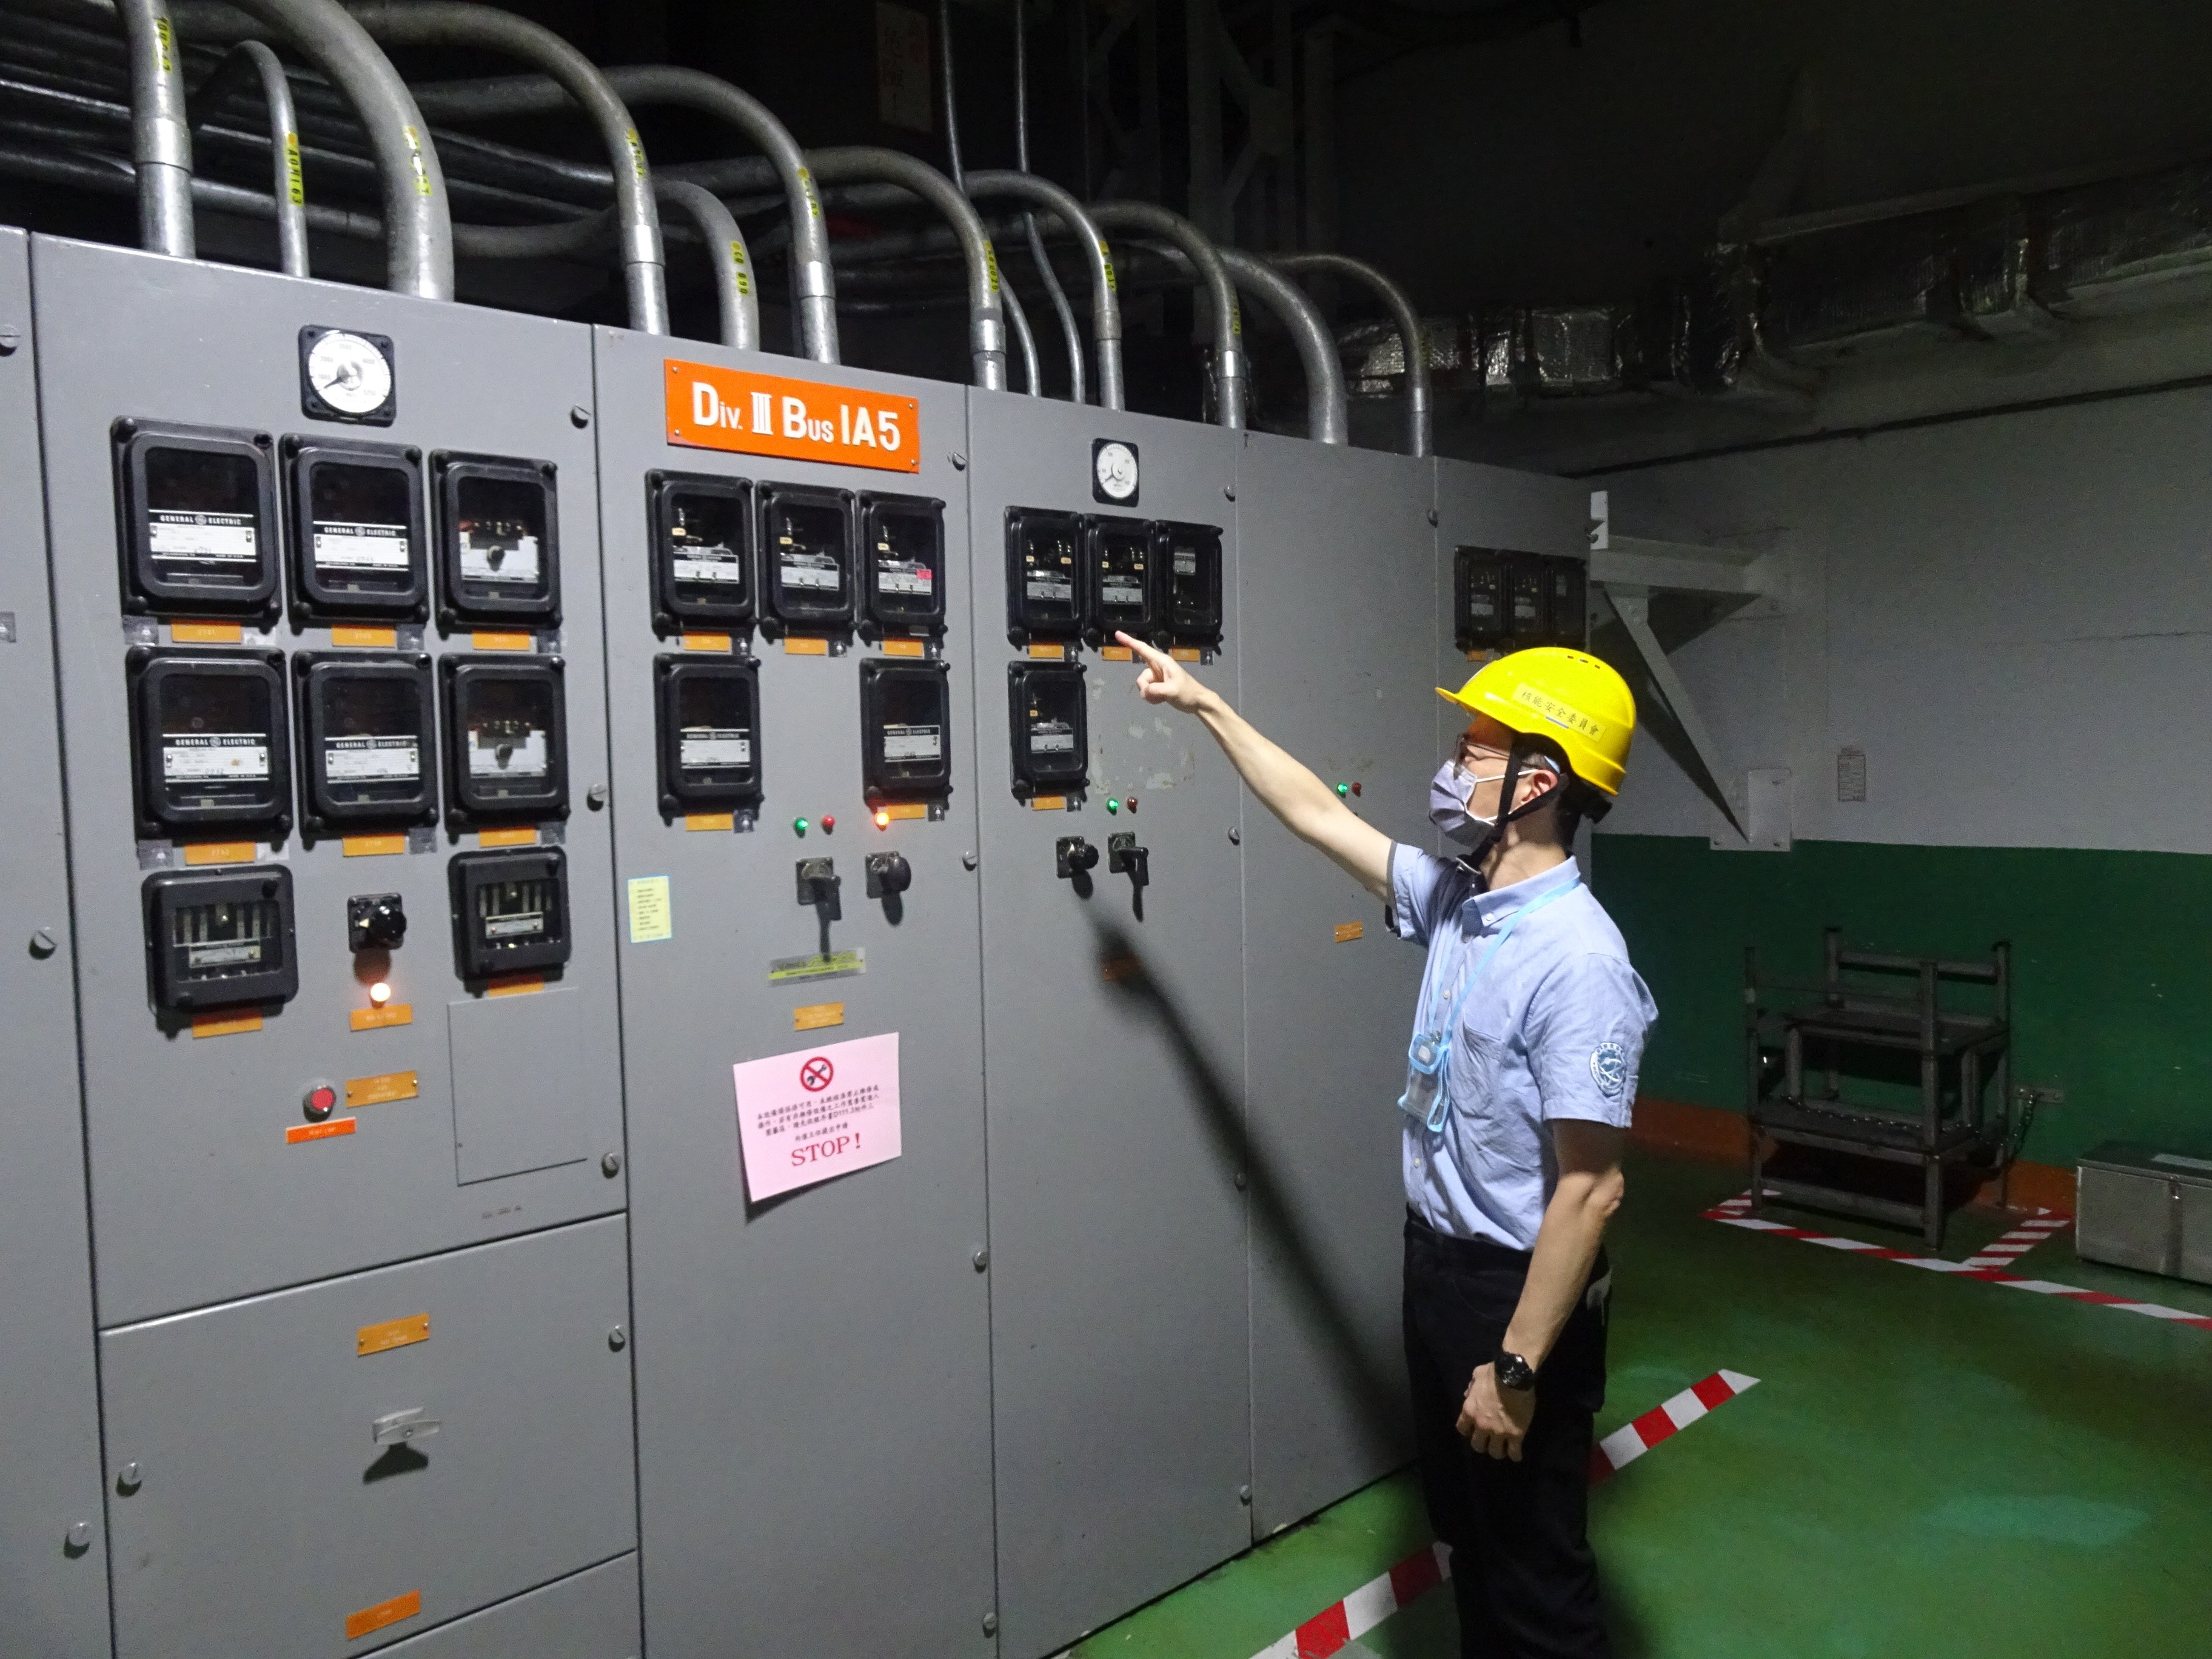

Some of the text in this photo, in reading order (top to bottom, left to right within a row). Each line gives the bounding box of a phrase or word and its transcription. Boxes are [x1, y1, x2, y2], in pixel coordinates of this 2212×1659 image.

[782, 395, 835, 443] Bus
[159, 515, 242, 526] GENERAL ELECTRIC
[1521, 690, 1599, 736] 核能安全委員會
